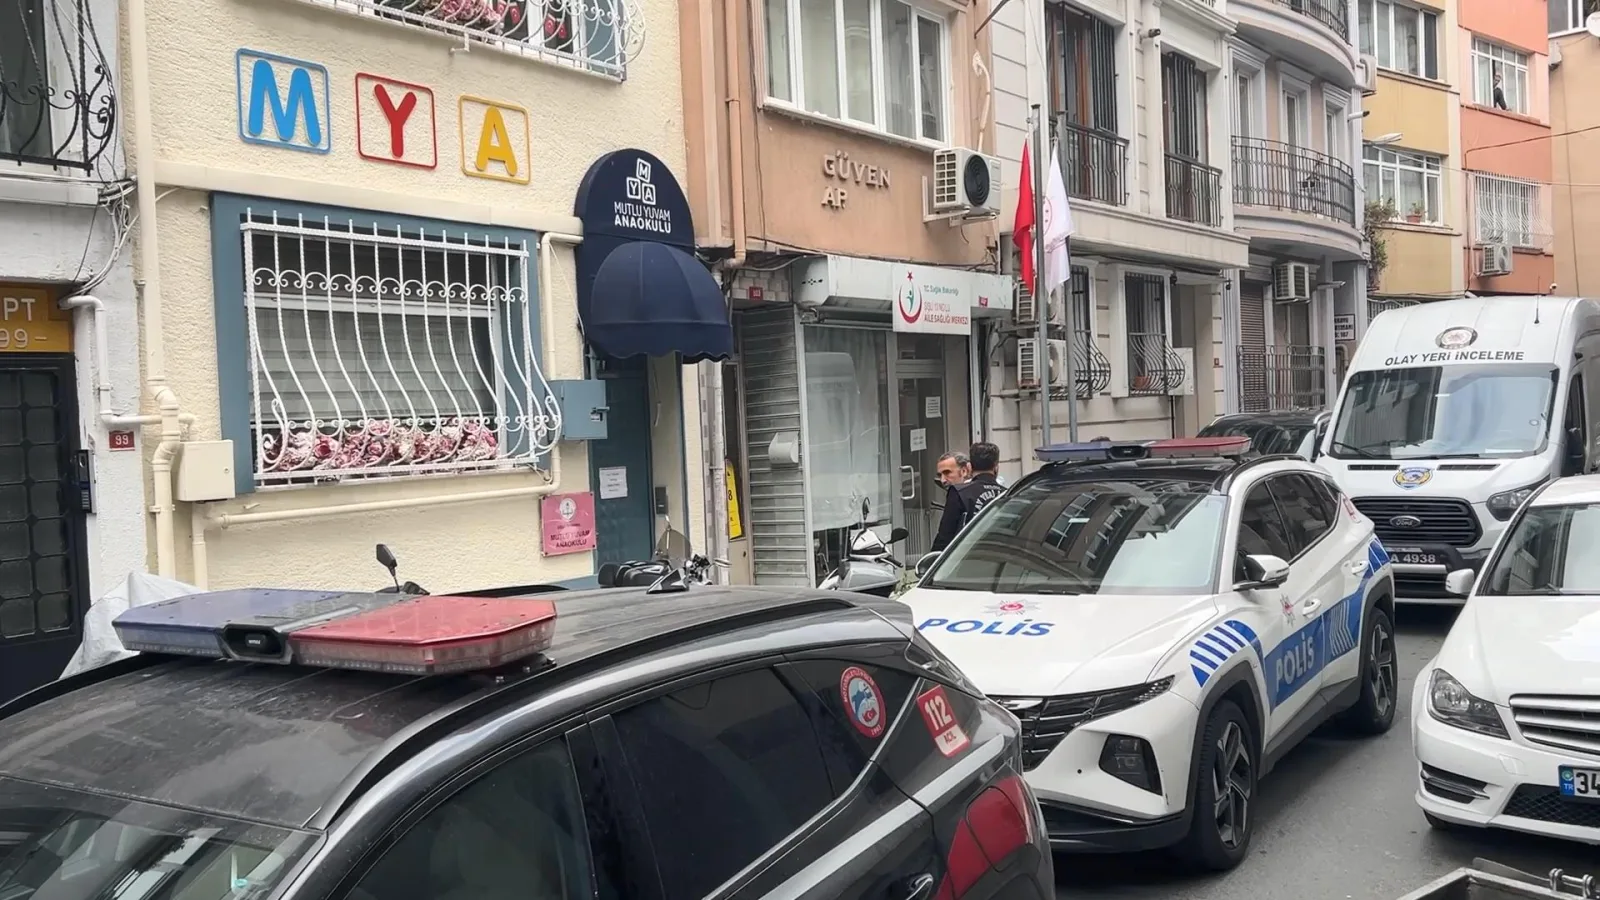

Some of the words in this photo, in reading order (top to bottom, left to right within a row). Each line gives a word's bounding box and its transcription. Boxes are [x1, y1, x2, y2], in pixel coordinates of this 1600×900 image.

[249, 59, 321, 147] M
[374, 83, 417, 158] Y
[473, 105, 518, 176] A
[824, 150, 890, 187] GÜVEN
[614, 201, 642, 217] MUTLU
[643, 205, 671, 221] YUVAM
[614, 214, 671, 234] ANAOKULU
[1384, 354, 1418, 366] OLAY
[1421, 351, 1451, 362] YERİ
[1454, 350, 1525, 361] İNCELEME
[115, 434, 129, 446] 99
[556, 538, 587, 548] ANAOKULU
[1402, 554, 1436, 563] 4938
[917, 618, 1056, 636] POLİS
[1276, 631, 1314, 693] POLİS
[924, 695, 953, 731] 112
[1563, 782, 1574, 791] TR
[1575, 771, 1600, 796] 34
